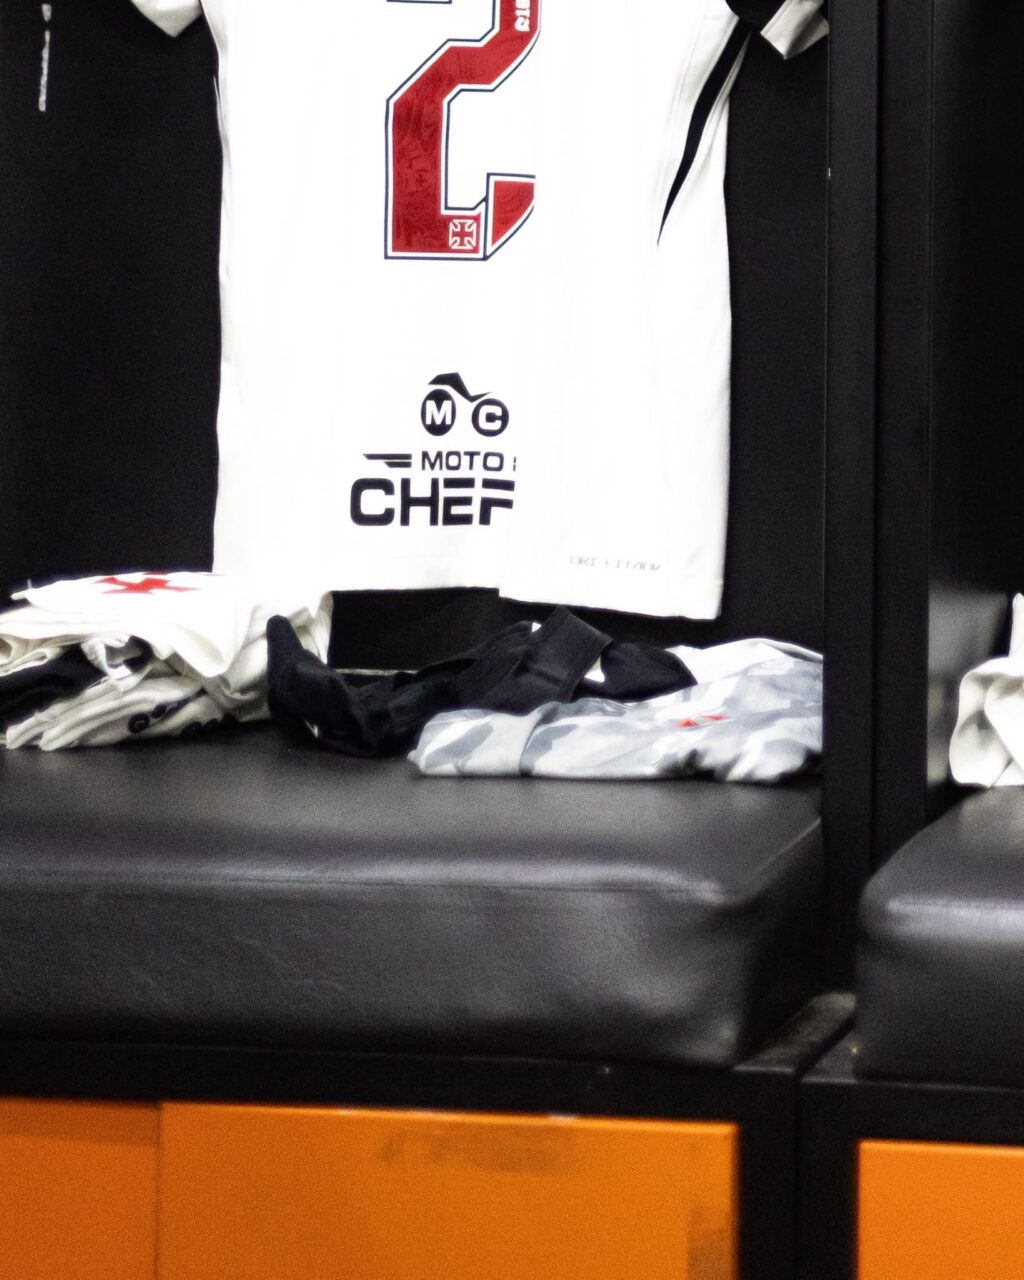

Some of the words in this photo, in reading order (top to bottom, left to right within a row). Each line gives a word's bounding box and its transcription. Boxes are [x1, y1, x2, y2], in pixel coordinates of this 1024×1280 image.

[425, 400, 452, 425] M
[478, 404, 503, 431] C
[422, 451, 504, 471] MOTO
